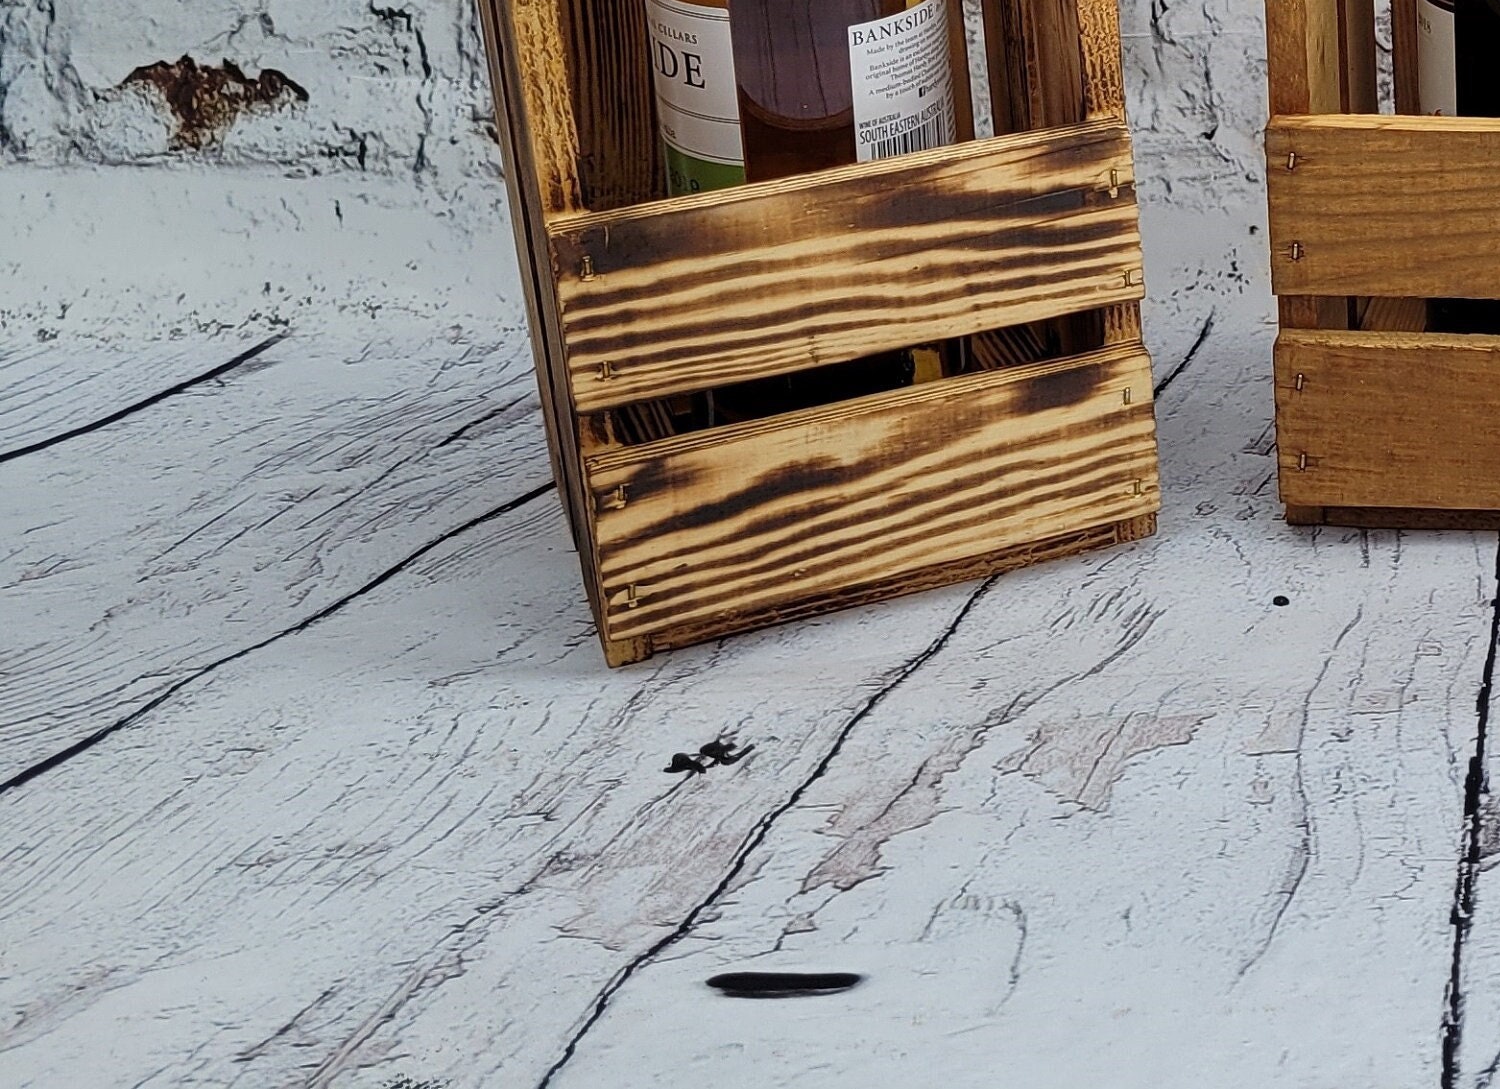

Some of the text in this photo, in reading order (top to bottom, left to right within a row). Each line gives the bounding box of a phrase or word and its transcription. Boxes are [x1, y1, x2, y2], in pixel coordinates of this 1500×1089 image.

[852, 2, 935, 47] BANKSIDE
[658, 23, 698, 45] CELLARS
[886, 44, 894, 52] by
[866, 66, 891, 80] original
[869, 58, 899, 71] Bankside
[860, 125, 888, 145] SOUTH
[889, 111, 920, 137] EASTERN
